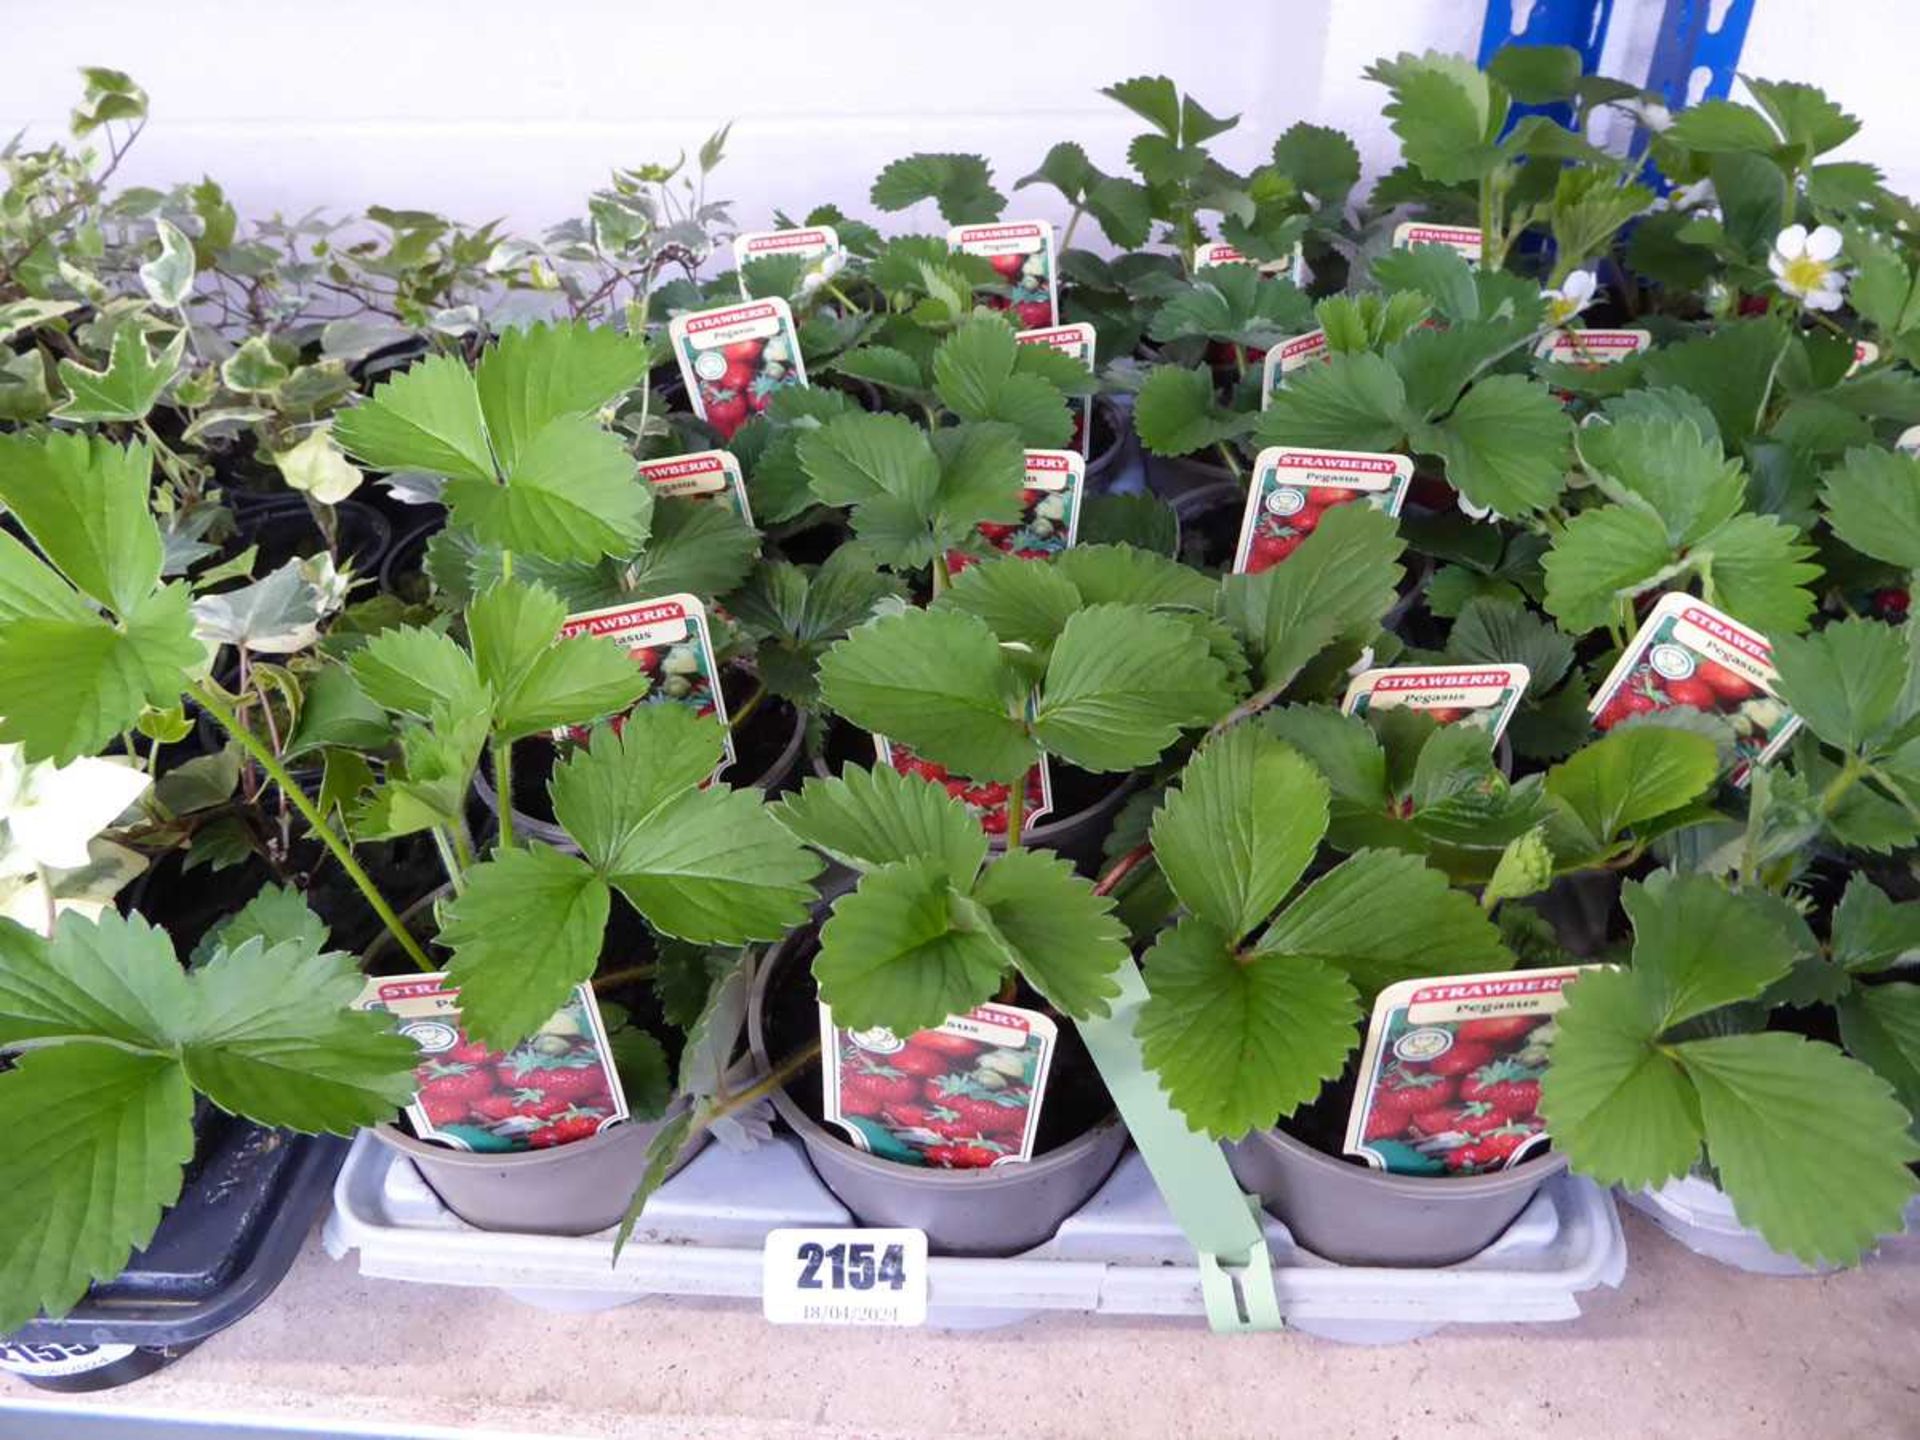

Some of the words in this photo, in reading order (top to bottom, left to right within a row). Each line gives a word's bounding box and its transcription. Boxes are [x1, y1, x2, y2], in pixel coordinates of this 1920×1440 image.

[1410, 230, 1483, 243] STRAWBERR
[687, 306, 774, 331] STRAWBERRY
[1281, 455, 1395, 472] STRAWBERRY
[1306, 472, 1360, 484] Pegasus
[1706, 641, 1764, 677] Pegasus
[1377, 673, 1508, 689] STRAWBERRY
[1404, 693, 1465, 704] Pegasus
[1456, 1000, 1539, 1014] Pegasus
[797, 1242, 906, 1290] 2154
